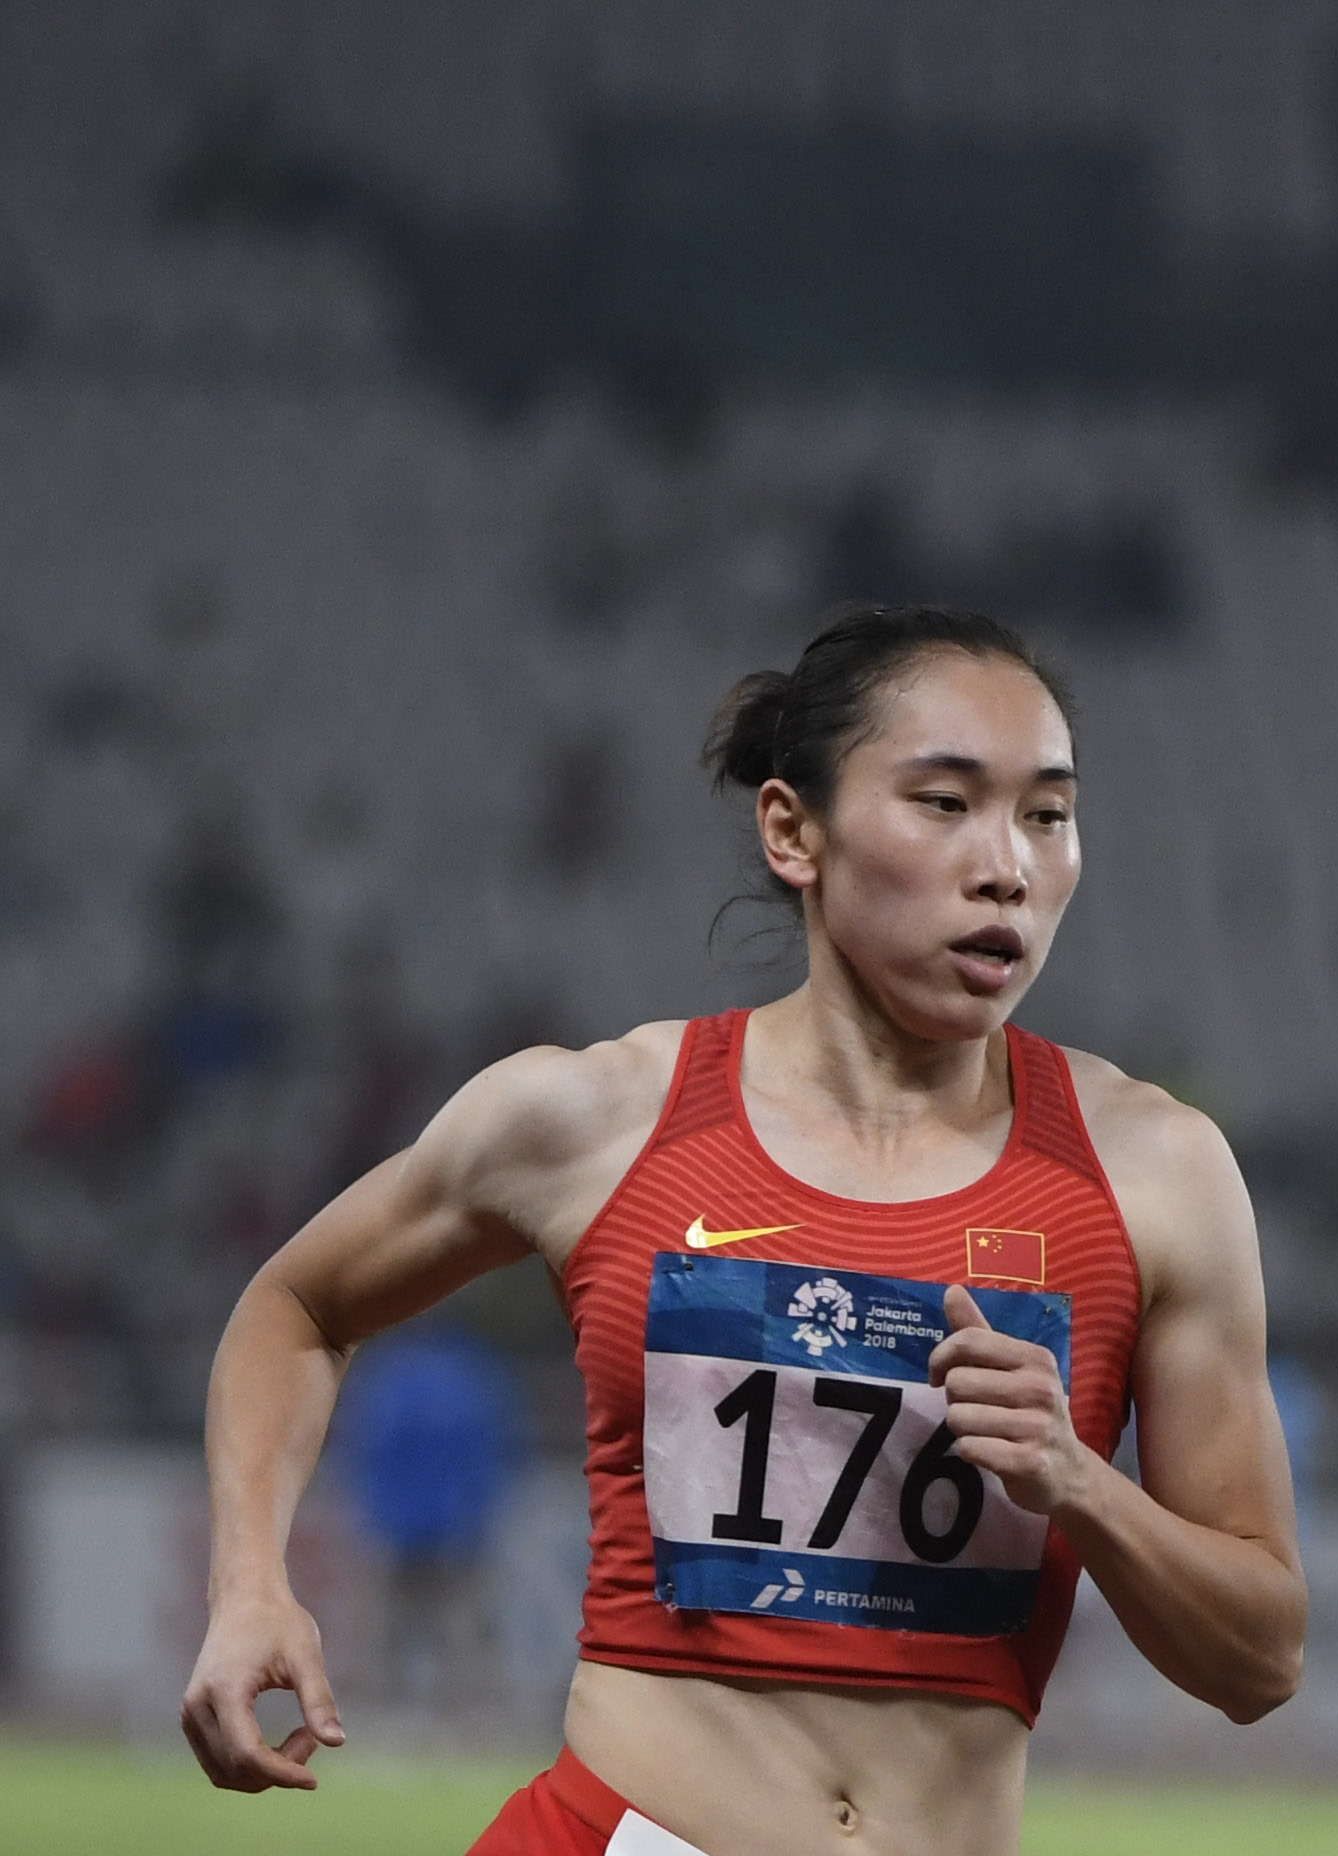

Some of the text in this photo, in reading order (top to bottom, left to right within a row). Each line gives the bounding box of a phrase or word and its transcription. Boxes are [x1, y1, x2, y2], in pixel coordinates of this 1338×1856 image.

[866, 1305, 922, 1322] Jakarta
[864, 1334, 896, 1349] 2018
[865, 1318, 944, 1342] Palembang
[711, 1369, 985, 1564] 176
[814, 1589, 915, 1612] PERTAMINA
